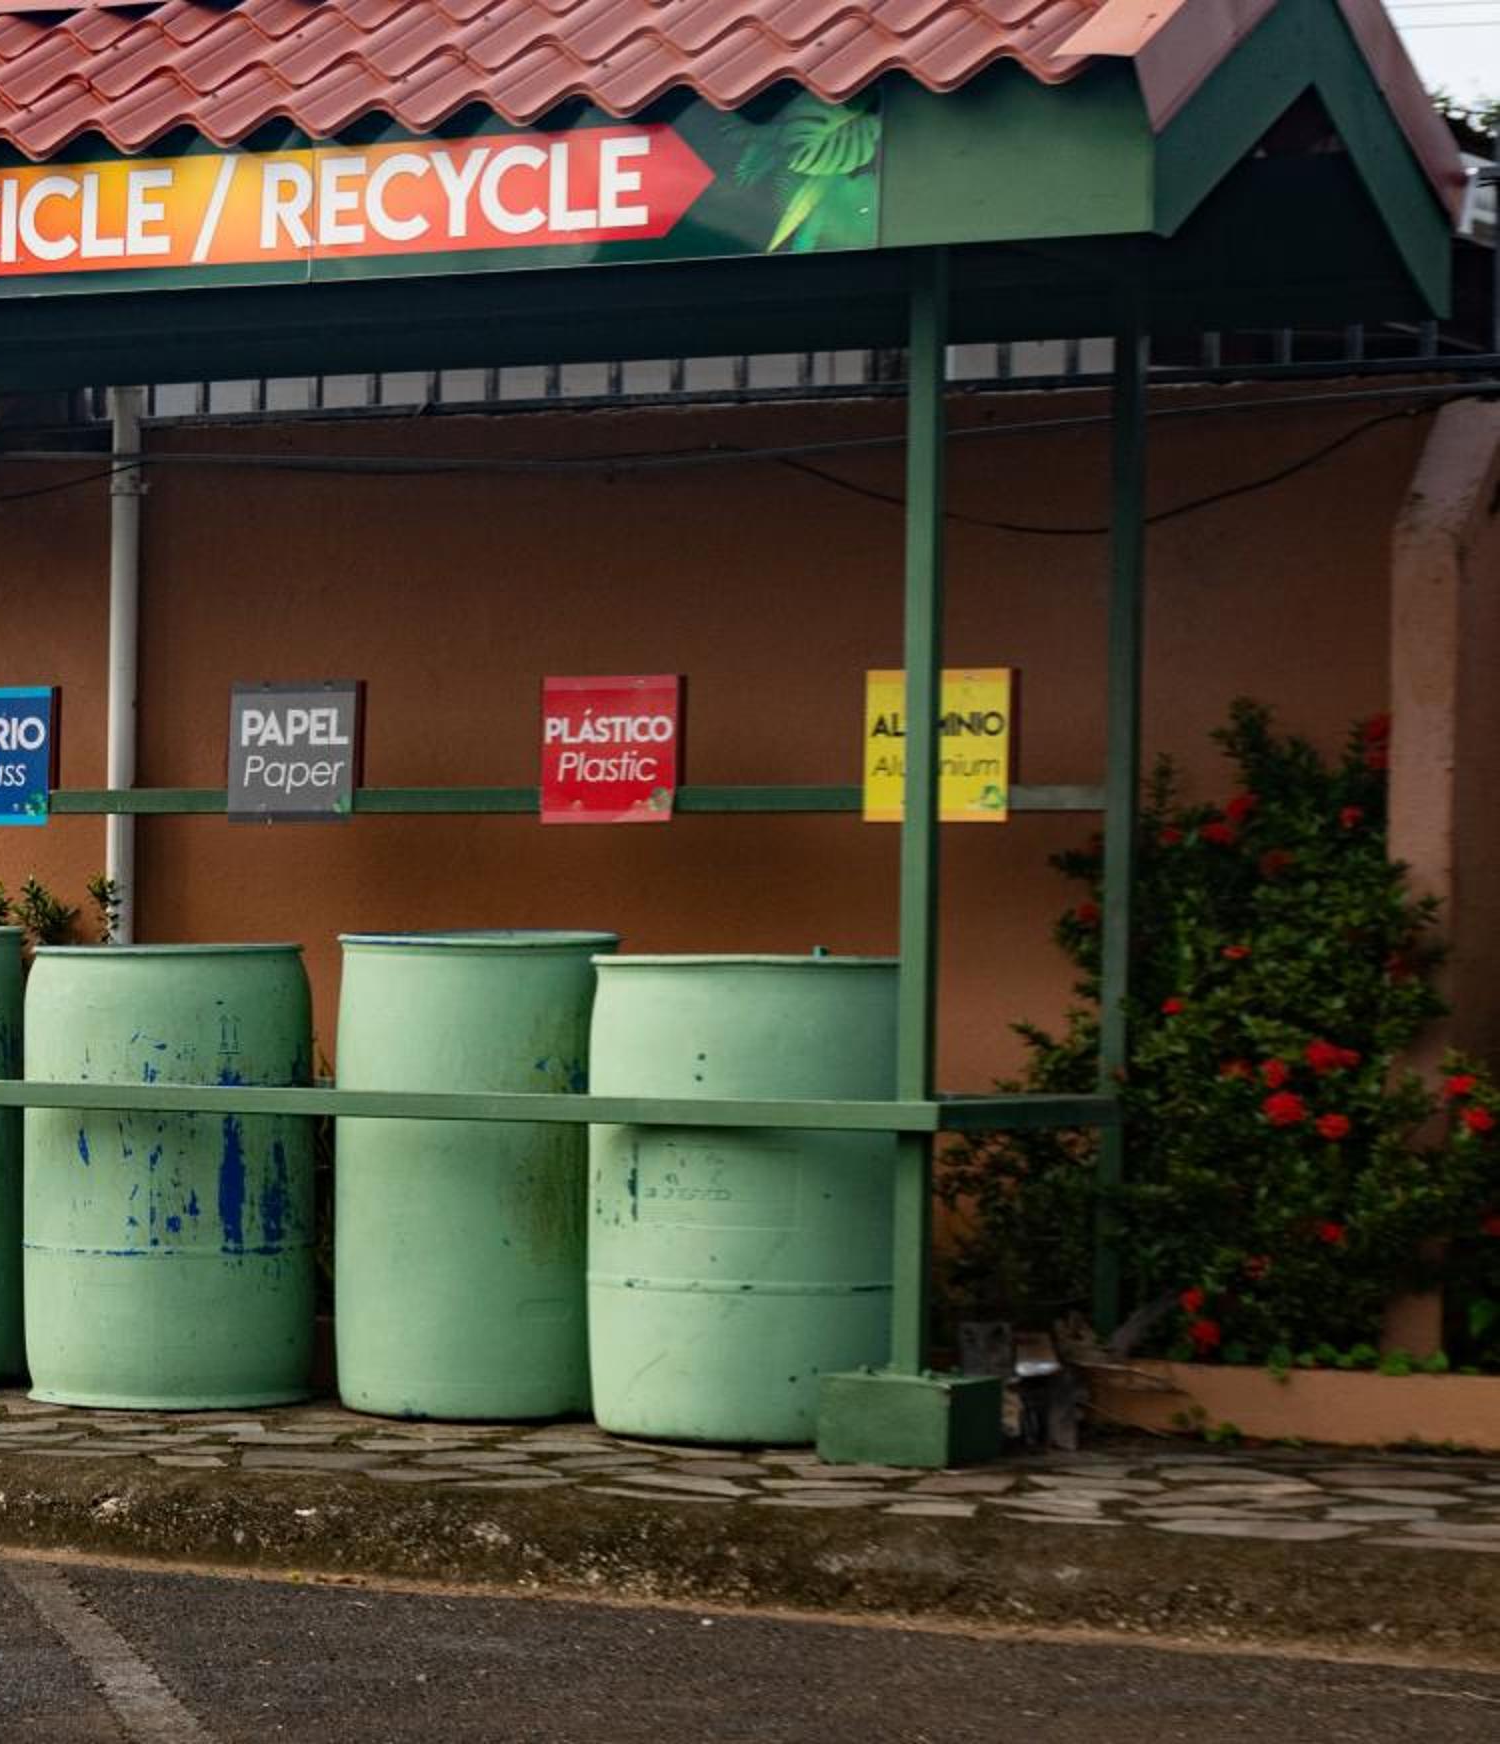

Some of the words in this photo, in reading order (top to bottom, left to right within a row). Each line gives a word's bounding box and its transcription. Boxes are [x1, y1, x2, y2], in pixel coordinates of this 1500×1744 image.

[192, 154, 238, 263] /
[258, 135, 651, 250] RECYCLE
[240, 707, 350, 747] PAPEL
[544, 707, 675, 745] PLÁSTICO
[242, 754, 346, 796] Paper
[556, 750, 659, 783] Plastic
